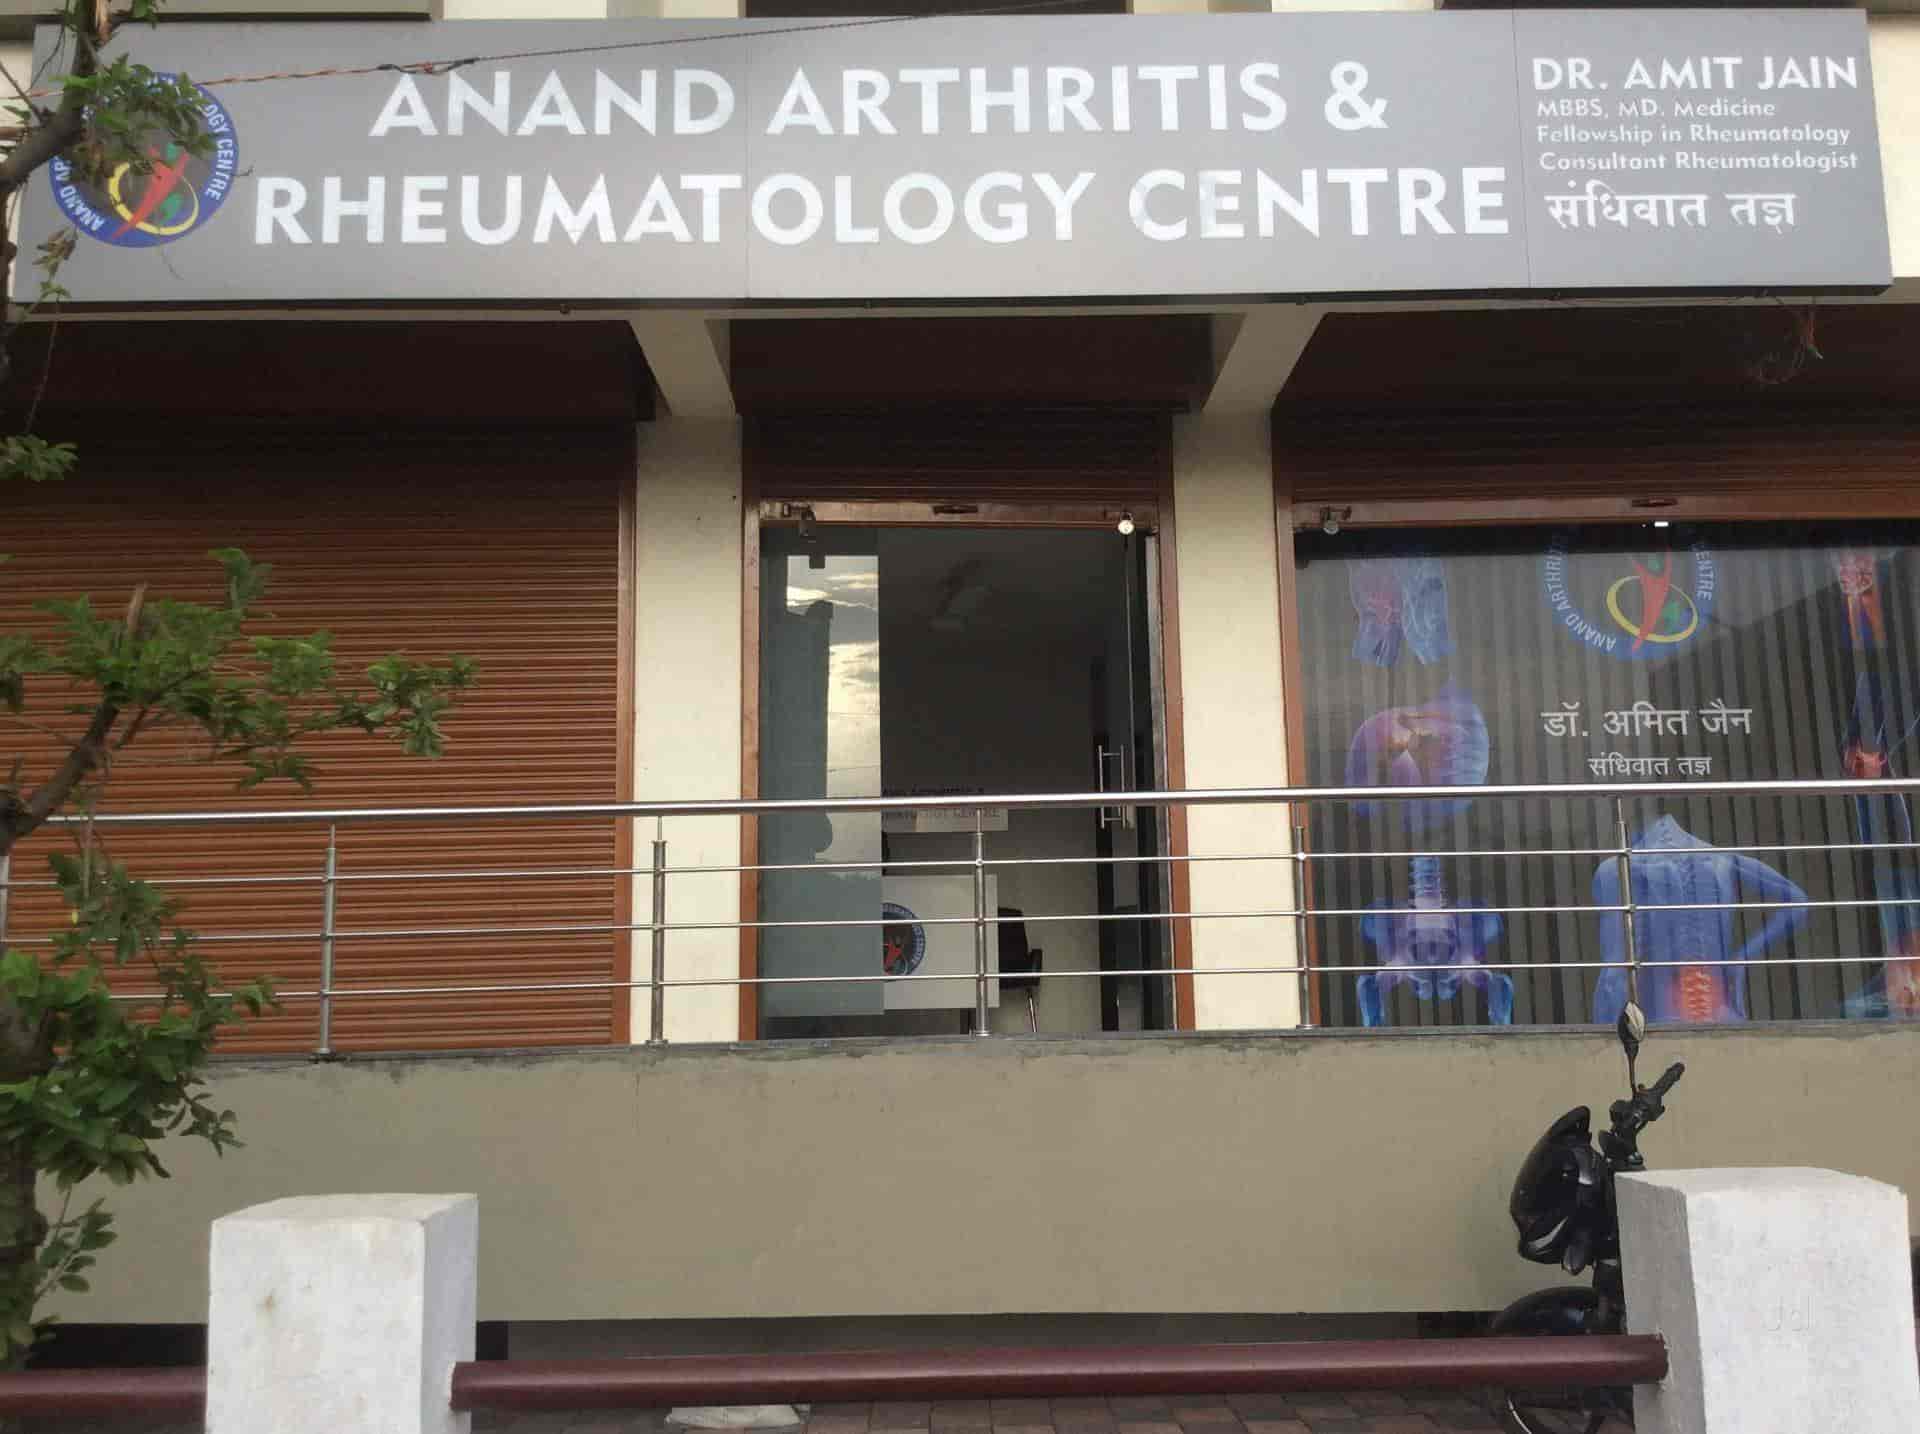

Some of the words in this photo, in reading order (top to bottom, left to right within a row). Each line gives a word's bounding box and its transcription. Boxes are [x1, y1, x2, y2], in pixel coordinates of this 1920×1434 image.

[1532, 56, 1608, 91] DR.
[1624, 55, 1743, 90] AMIT
[1757, 55, 1858, 90] JAIN
[368, 68, 736, 137] ANAND
[765, 61, 1288, 136] ARTHRITIS
[1323, 60, 1390, 132] &
[1674, 99, 1776, 118] Medicine
[1537, 124, 1654, 145] Fellowship
[1662, 124, 1682, 142] in
[1690, 123, 1851, 145] Rheumatology
[204, 138, 234, 201] CENTRE
[1540, 152, 1666, 171] Consultant
[1676, 149, 1859, 173] Rheumatologist
[58, 185, 105, 232] ANAND
[255, 172, 1097, 246] RHEUMATOLOGY
[1128, 166, 1510, 241] CENTRE
[1544, 178, 1708, 230] संधिवात
[1566, 612, 1617, 652] ANAND
[1541, 702, 1589, 737] डॉ.
[1602, 701, 1689, 737] अमित
[1698, 698, 1753, 736] जैन
[1588, 752, 1670, 777] संधिवात
